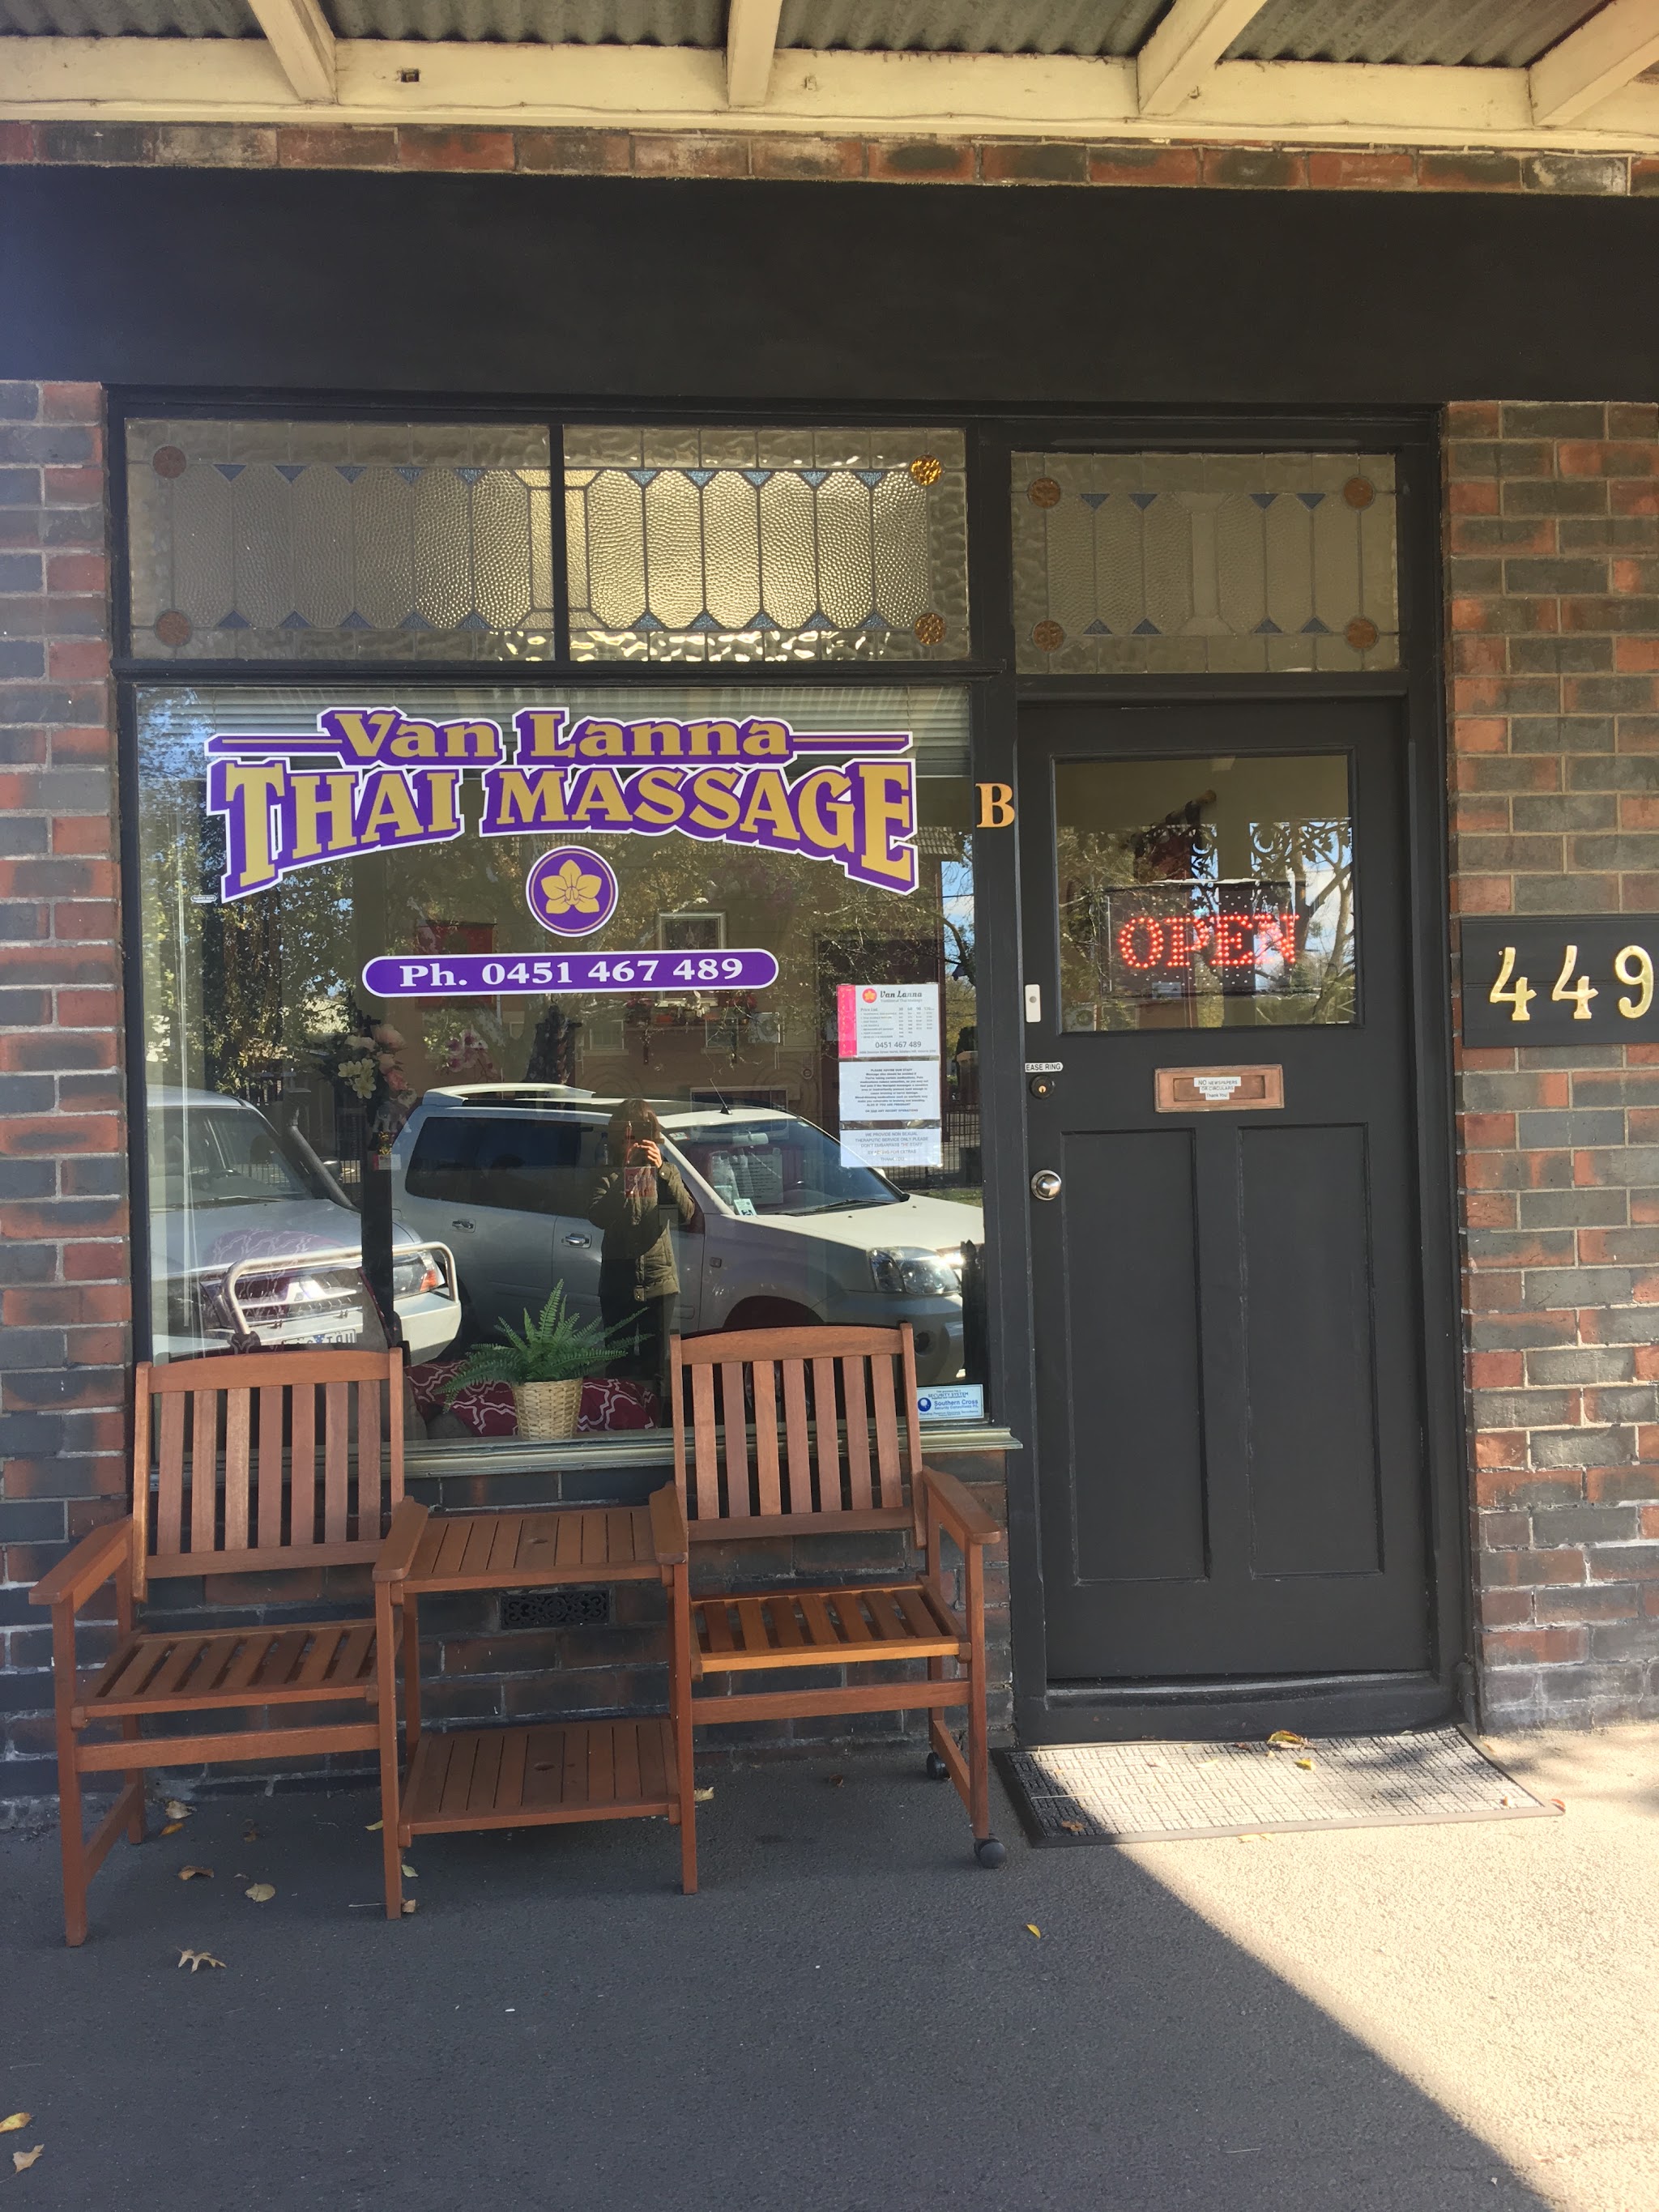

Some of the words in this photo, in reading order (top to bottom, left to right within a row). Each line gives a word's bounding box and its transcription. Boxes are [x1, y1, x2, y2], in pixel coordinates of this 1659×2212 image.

[333, 712, 498, 758] Van
[528, 712, 790, 759] Lanna
[224, 761, 457, 888] THAI
[495, 763, 913, 883] MASSAGE
[975, 782, 1015, 829] B
[1116, 913, 1301, 970] OPEN
[399, 963, 468, 987] Ph.
[481, 961, 574, 987] 0451
[587, 959, 659, 985] 467
[672, 957, 744, 982] 489
[897, 990, 923, 998] Lanna
[1489, 944, 1654, 1021] 449
